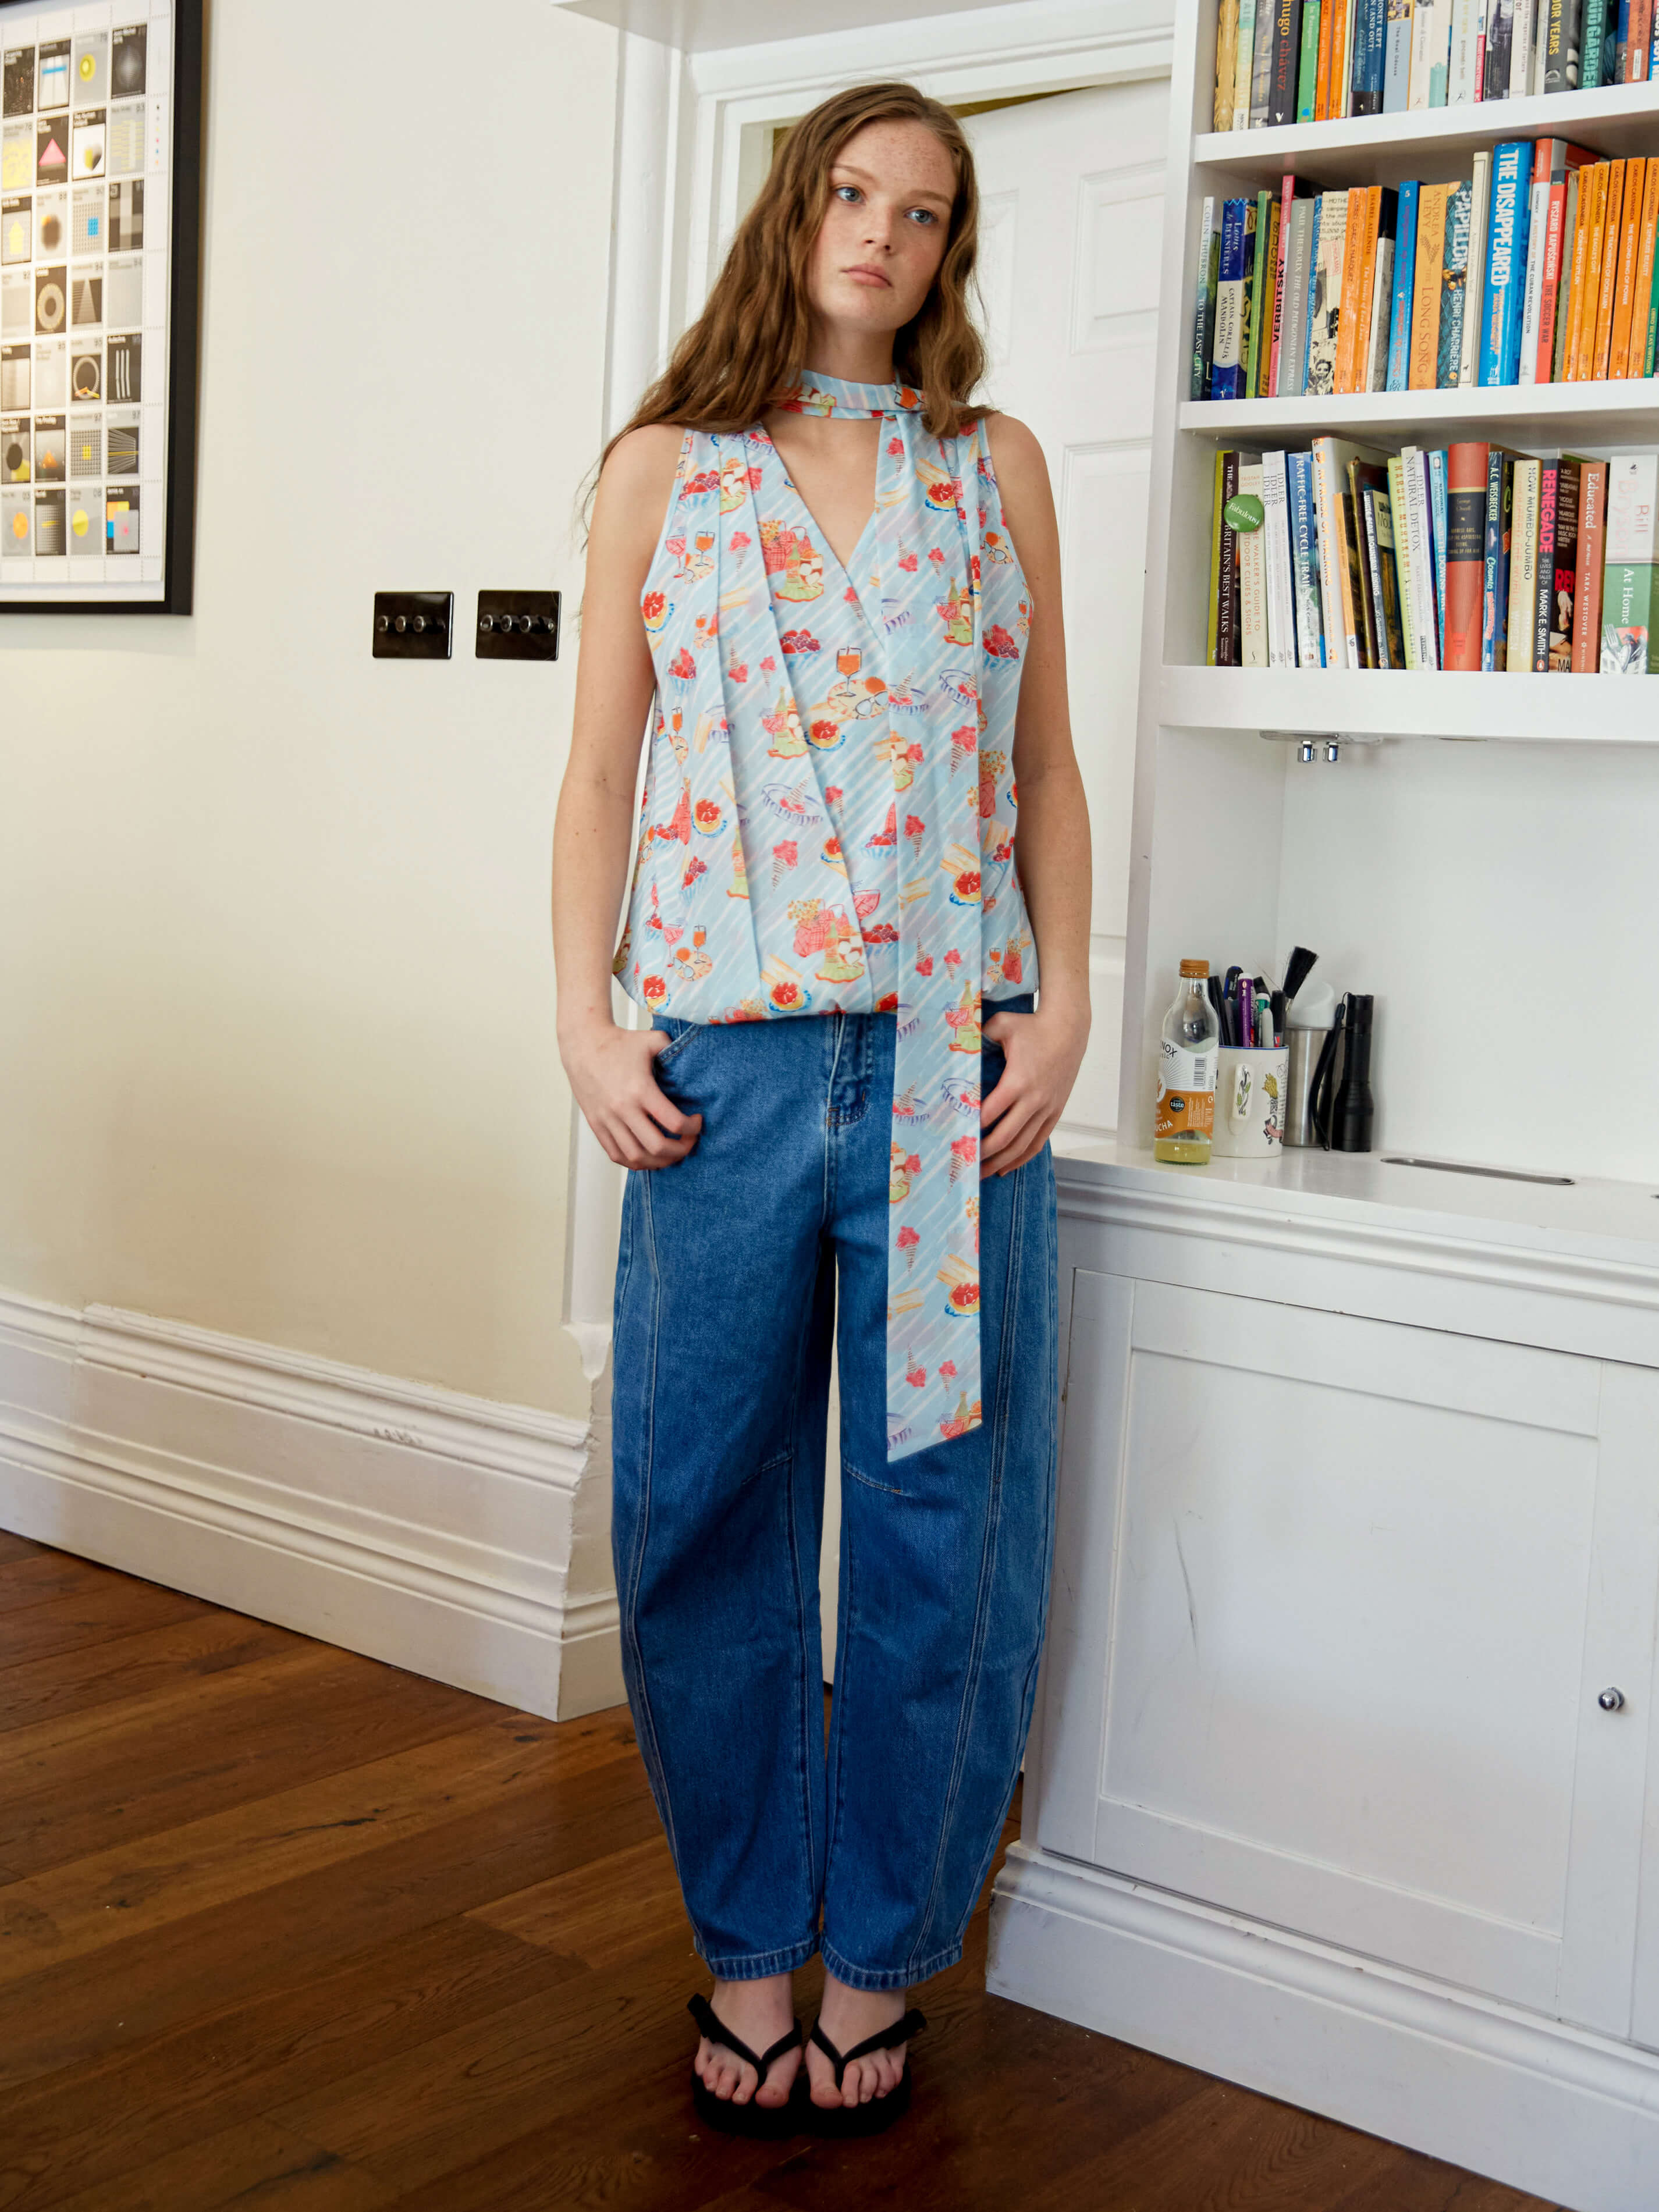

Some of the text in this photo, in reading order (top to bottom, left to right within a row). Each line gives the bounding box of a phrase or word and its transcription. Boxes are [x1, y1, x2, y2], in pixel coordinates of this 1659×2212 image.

[1548, 20, 1562, 55] YEARS
[1583, 26, 1601, 88] GARDEN
[1404, 190, 1411, 198] 5
[1423, 200, 1432, 228] LEVY
[1431, 190, 1441, 236] ANDREA
[1202, 205, 1211, 234] COLIN
[1298, 205, 1307, 226] PAUL
[1452, 190, 1472, 269] PAPILLON
[1491, 149, 1519, 286] THE DISAPPEARED
[1550, 200, 1560, 232] RYSZARD
[1199, 238, 1209, 284] THUBRON
[1198, 297, 1205, 311] TO
[1219, 297, 1228, 344] MANDOLIN
[1273, 259, 1285, 343] VERBITSKY
[1419, 287, 1434, 328] LONG
[1452, 289, 1463, 318] HENRI
[1543, 298, 1552, 326] SOCCER
[1289, 311, 1299, 357] PATAGONIAN
[1417, 332, 1430, 373] SONG
[1541, 329, 1550, 343] WAR
[1287, 358, 1296, 391] EXPRESS
[1406, 456, 1418, 509] NATURAL
[1416, 475, 1424, 506] IDLER
[1489, 482, 1499, 521] WEISBECKER
[1585, 472, 1600, 529] Educated
[1295, 454, 1310, 595] TRAFFIC-FREE CYCLE TRAILS
[1394, 465, 1411, 573] HARUKI MURAKAMI
[1410, 512, 1421, 552] DETOX
[1523, 467, 1537, 581] HOW MUMBO-JUMBO
[1539, 470, 1557, 553] RENEGADE
[1612, 479, 1638, 557] Bryson
[1633, 504, 1650, 533] Bill
[1223, 525, 1232, 572] BRITAIN'S
[1367, 536, 1377, 571] MOUNTAIN
[1436, 521, 1446, 590] SOUTH DOWNS
[1222, 575, 1231, 598] BEST
[1621, 568, 1635, 625] At Home
[1221, 600, 1229, 632] WALKS
[1255, 620, 1260, 631] TO
[1537, 589, 1548, 655] MARK E. SMITH
[1581, 595, 1589, 636] WESTOVER
